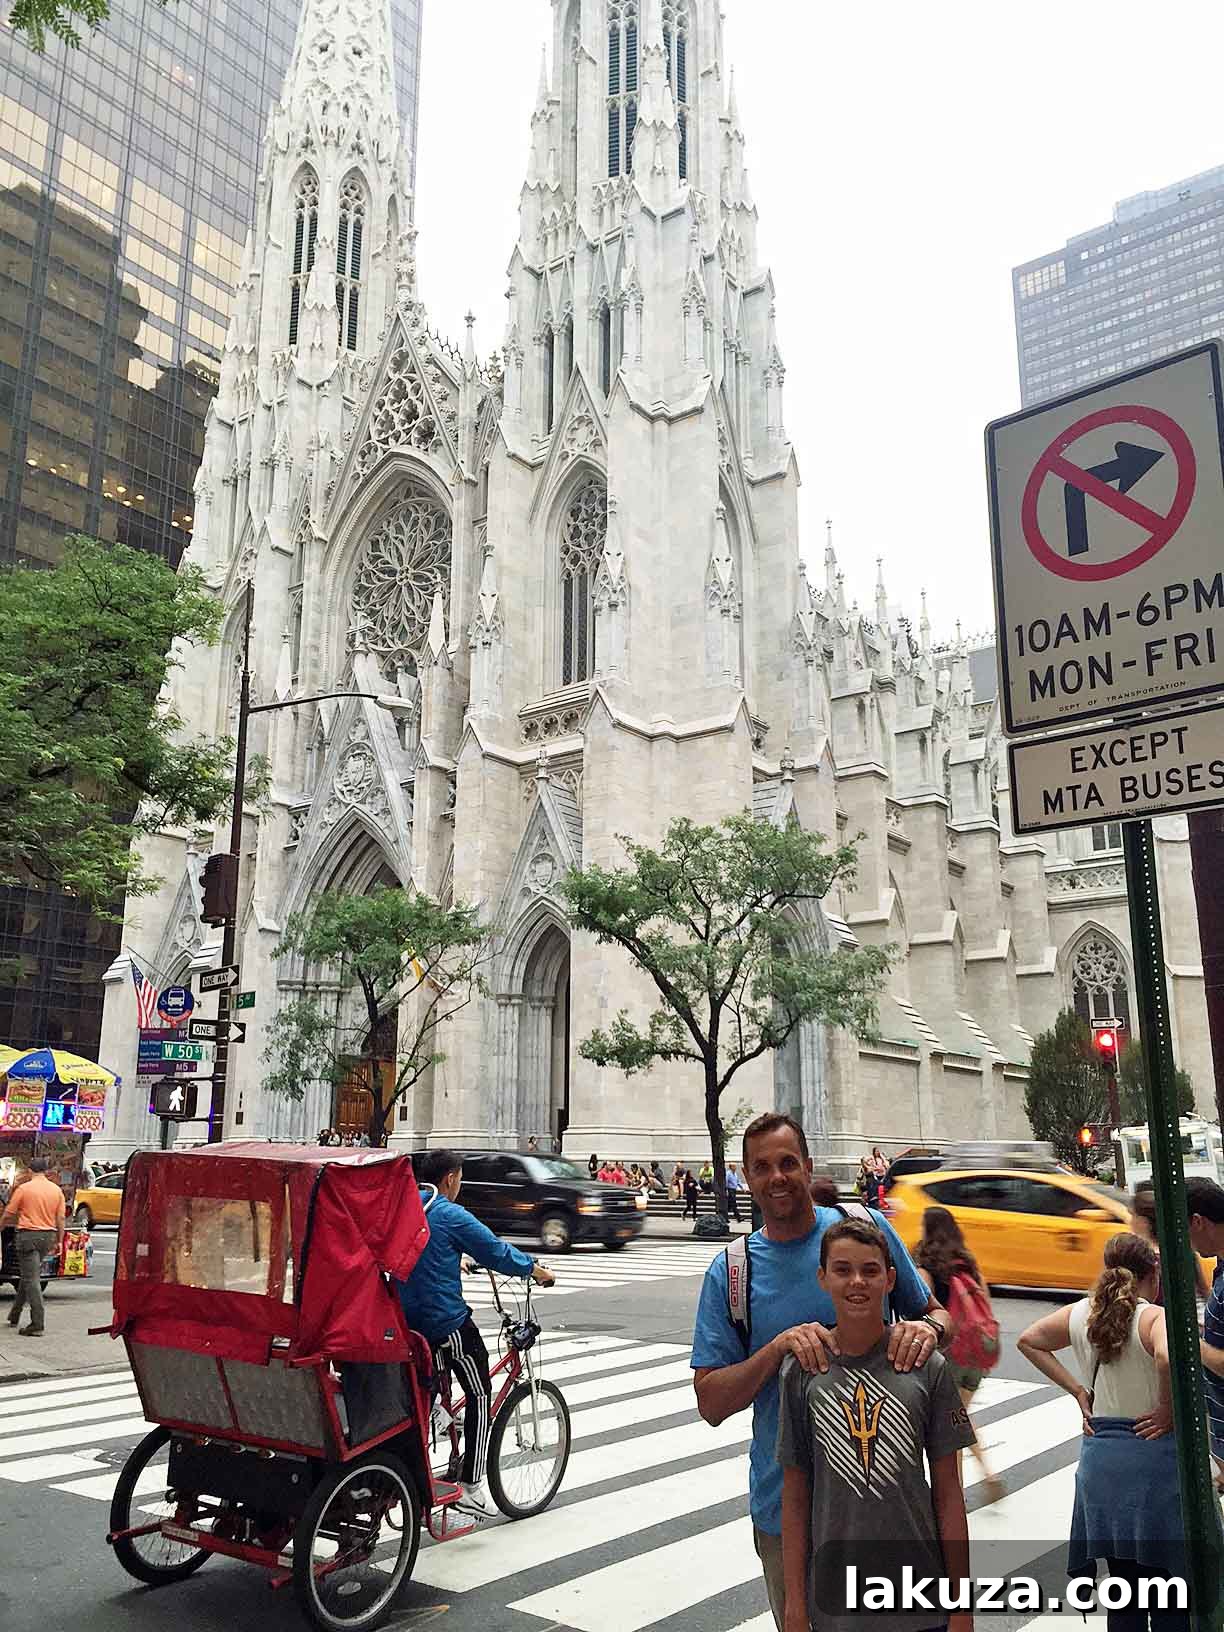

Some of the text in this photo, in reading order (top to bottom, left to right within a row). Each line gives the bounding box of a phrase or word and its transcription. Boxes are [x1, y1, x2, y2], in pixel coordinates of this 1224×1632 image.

[1014, 572, 1224, 656] 10AM-6PM
[1028, 627, 1216, 702] MON-FRI
[1058, 703, 1080, 712] DEPT
[1106, 680, 1187, 702] TRANSPORTATION
[1070, 726, 1188, 773] EXCEPT
[1043, 760, 1224, 815] MTA BUSES
[203, 976, 215, 986] ONE
[238, 995, 244, 1008] 5
[194, 1025, 212, 1035] ONE
[164, 1044, 174, 1057] W
[178, 1045, 193, 1059] 50
